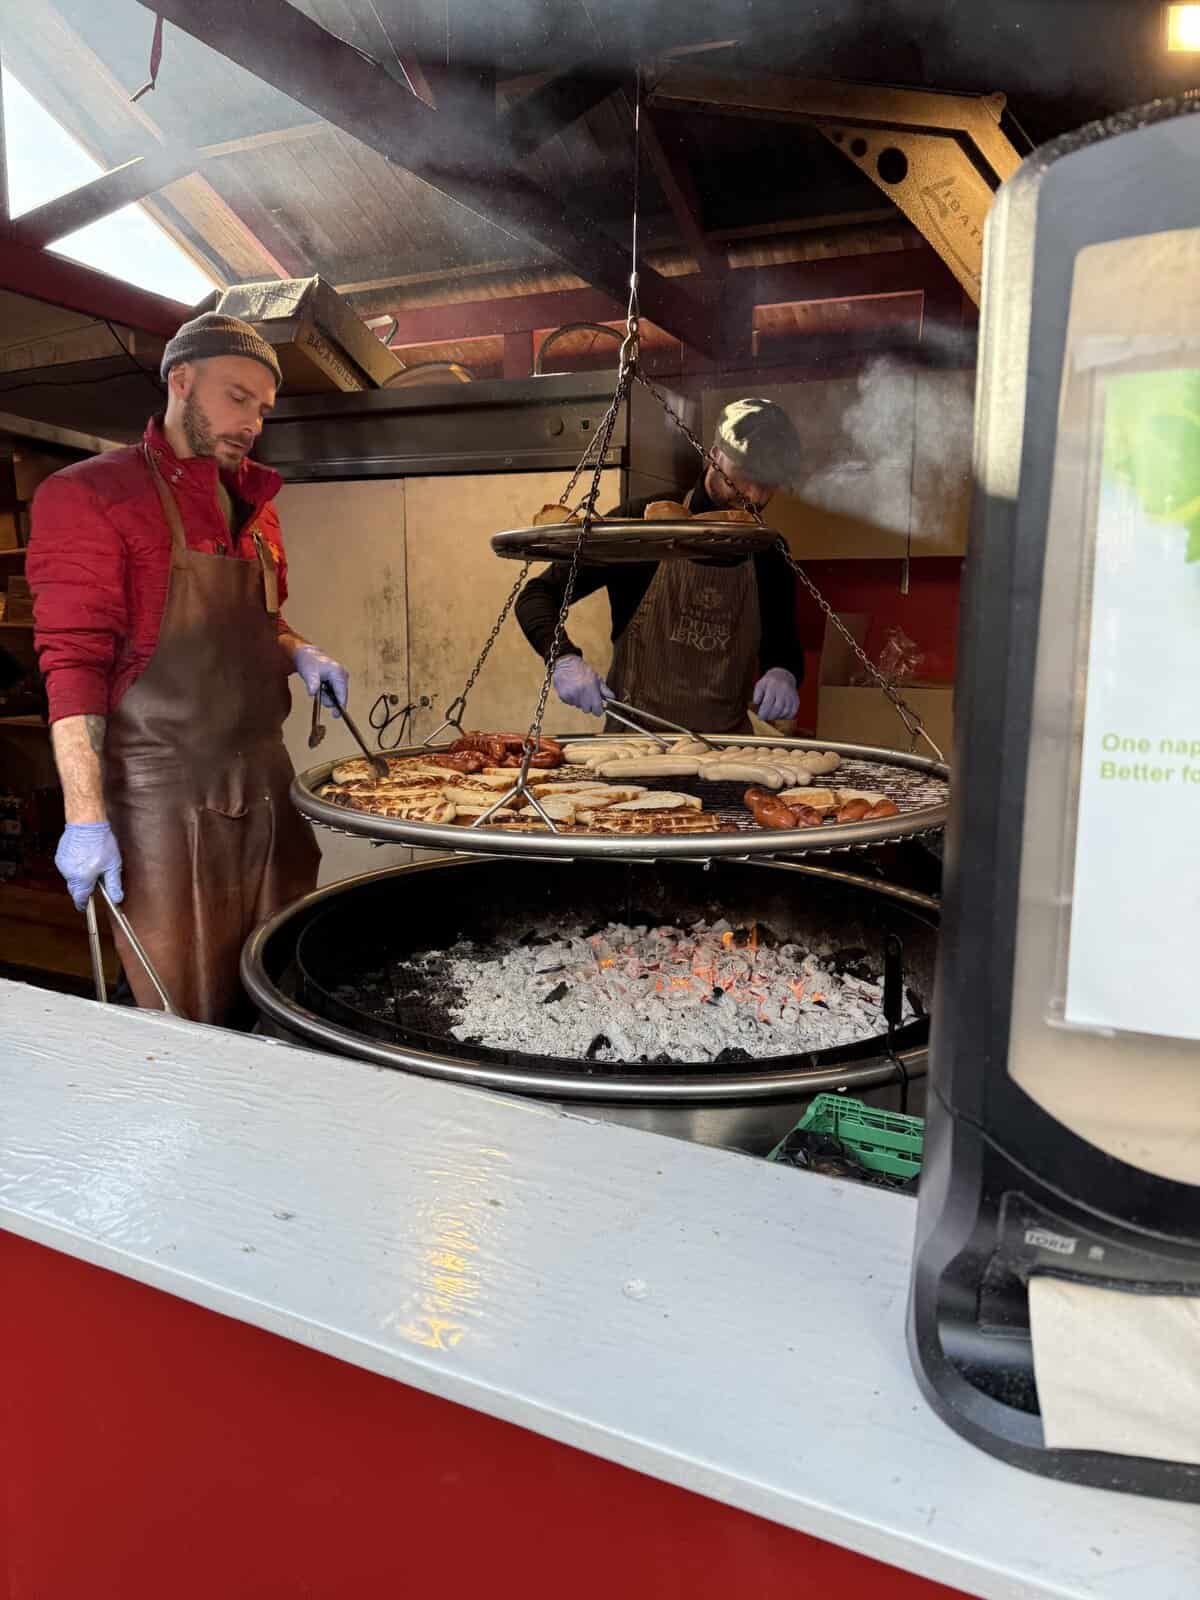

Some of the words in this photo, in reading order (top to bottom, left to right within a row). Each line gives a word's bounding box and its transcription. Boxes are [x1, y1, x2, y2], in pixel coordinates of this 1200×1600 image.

[669, 622, 731, 651] LEROY
[1101, 732, 1151, 754] One
[1100, 760, 1176, 783] Better
[1027, 1231, 1073, 1252] TORK
